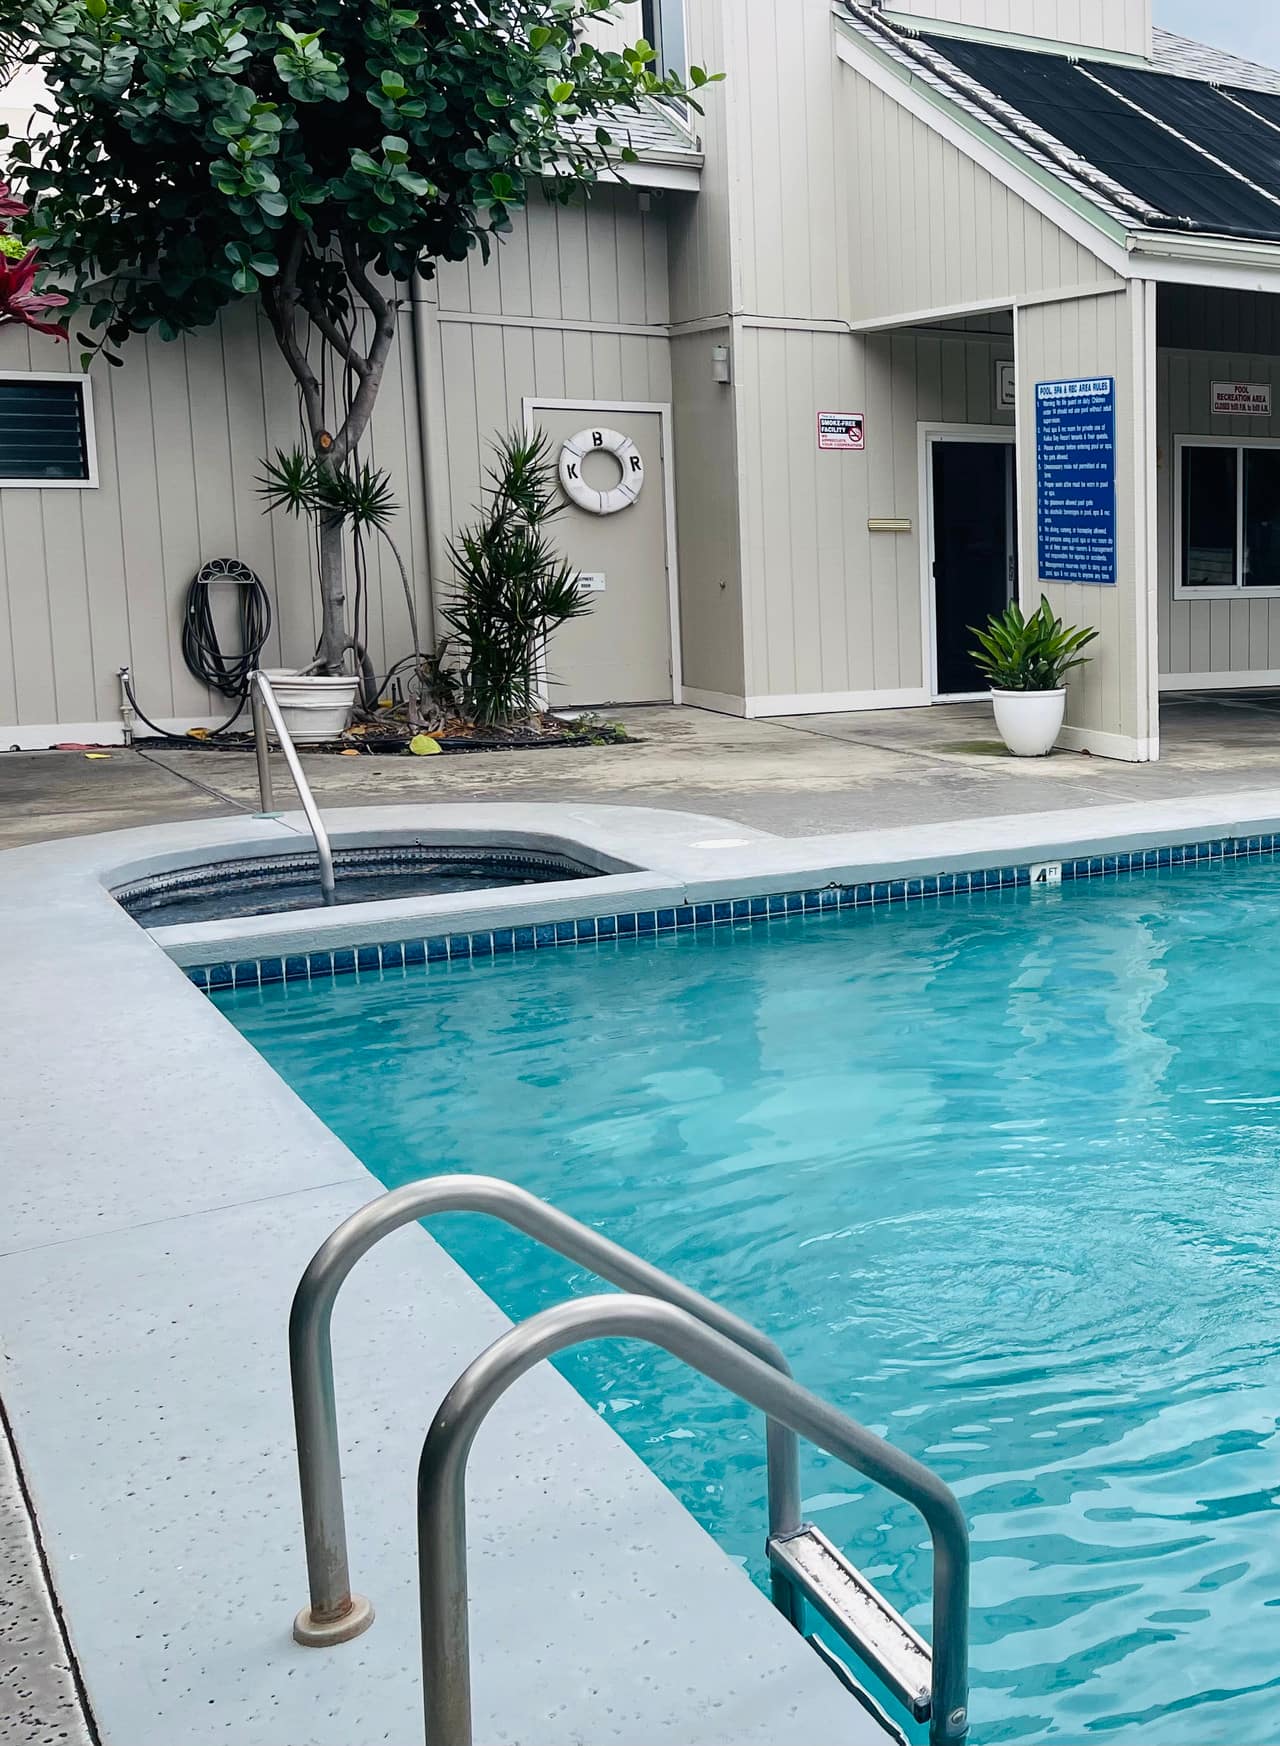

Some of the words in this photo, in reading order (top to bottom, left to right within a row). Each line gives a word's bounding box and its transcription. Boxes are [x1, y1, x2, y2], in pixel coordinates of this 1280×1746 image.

[1069, 385, 1077, 393] REC
[1079, 384, 1091, 392] AREA
[1093, 382, 1107, 391] RULES
[1234, 385, 1249, 393] POOL
[1216, 392, 1250, 401] RECREATION
[592, 431, 603, 447] B
[567, 463, 578, 479] K
[630, 456, 641, 472] R
[1035, 868, 1047, 882] 4
[1049, 867, 1057, 876] FT
